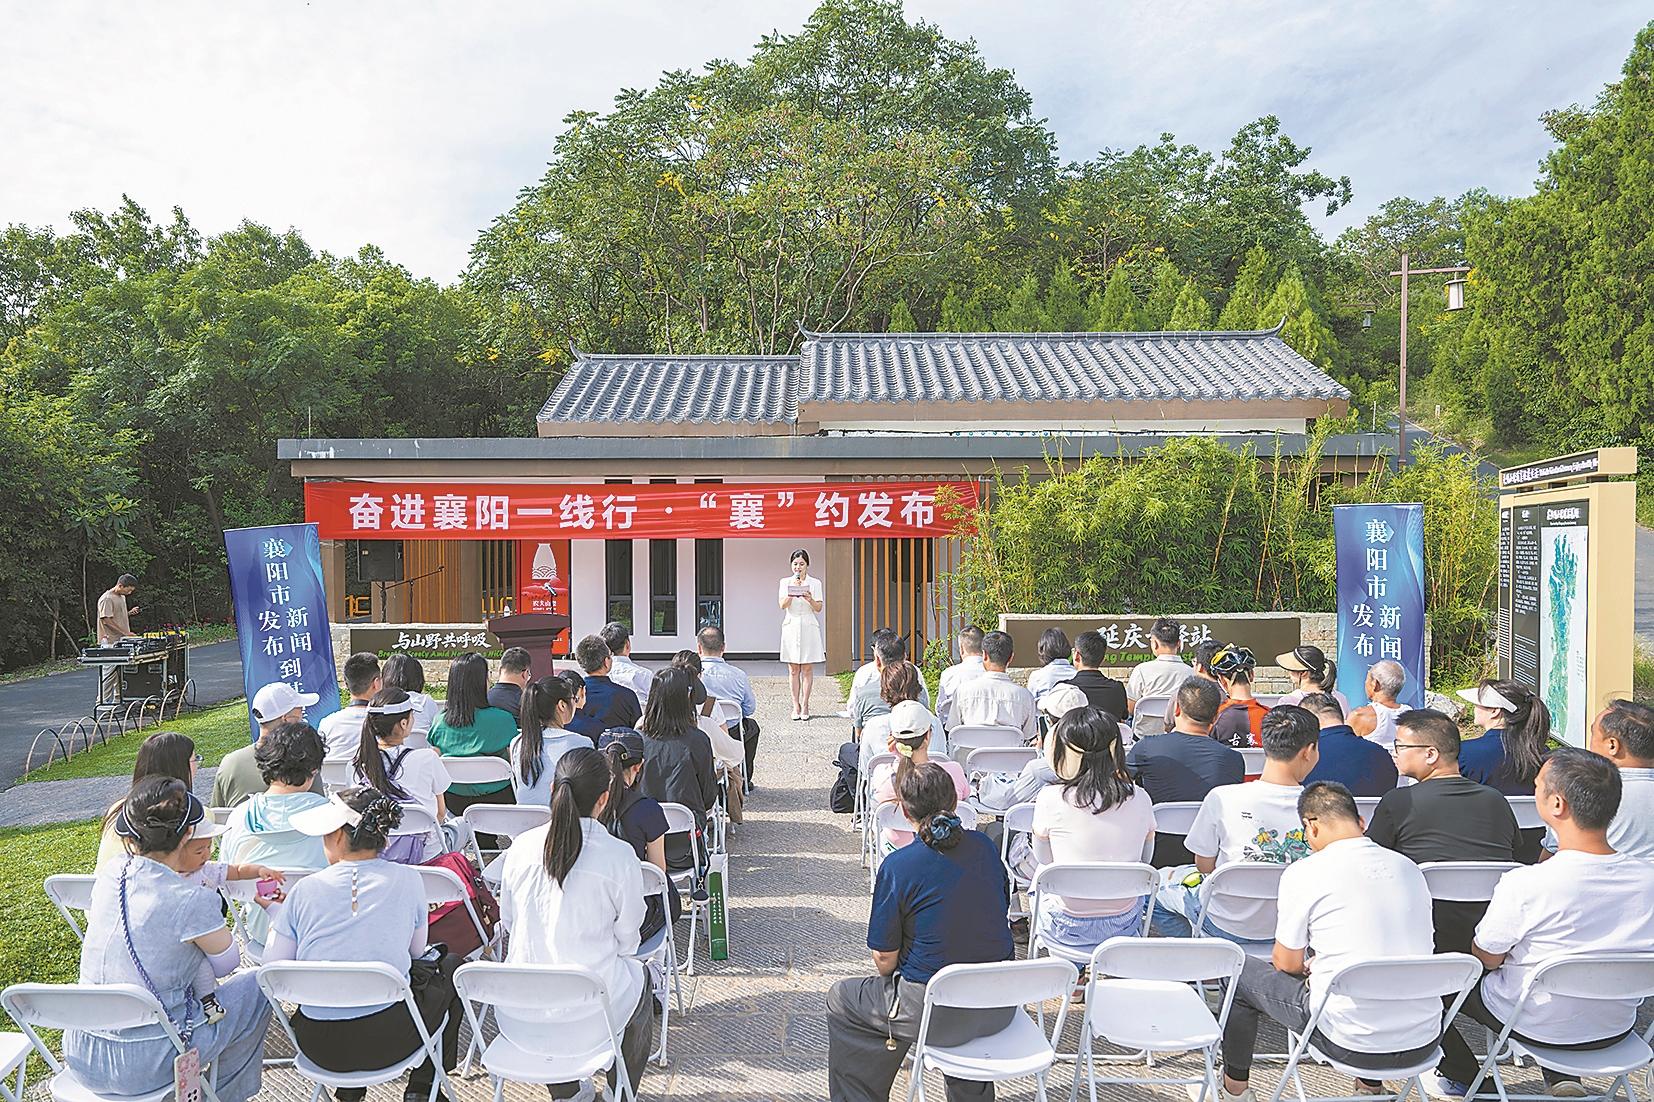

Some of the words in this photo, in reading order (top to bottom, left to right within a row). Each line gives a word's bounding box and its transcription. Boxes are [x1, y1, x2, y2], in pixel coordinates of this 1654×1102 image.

[263, 537, 291, 606] 襄阳市
[1365, 518, 1388, 600] 襄阳市
[258, 611, 284, 657] 发布
[285, 607, 312, 653] 新闻
[391, 631, 492, 650] 与山野共呼吸
[1352, 603, 1374, 657] 发布
[1379, 604, 1402, 660] 新闻
